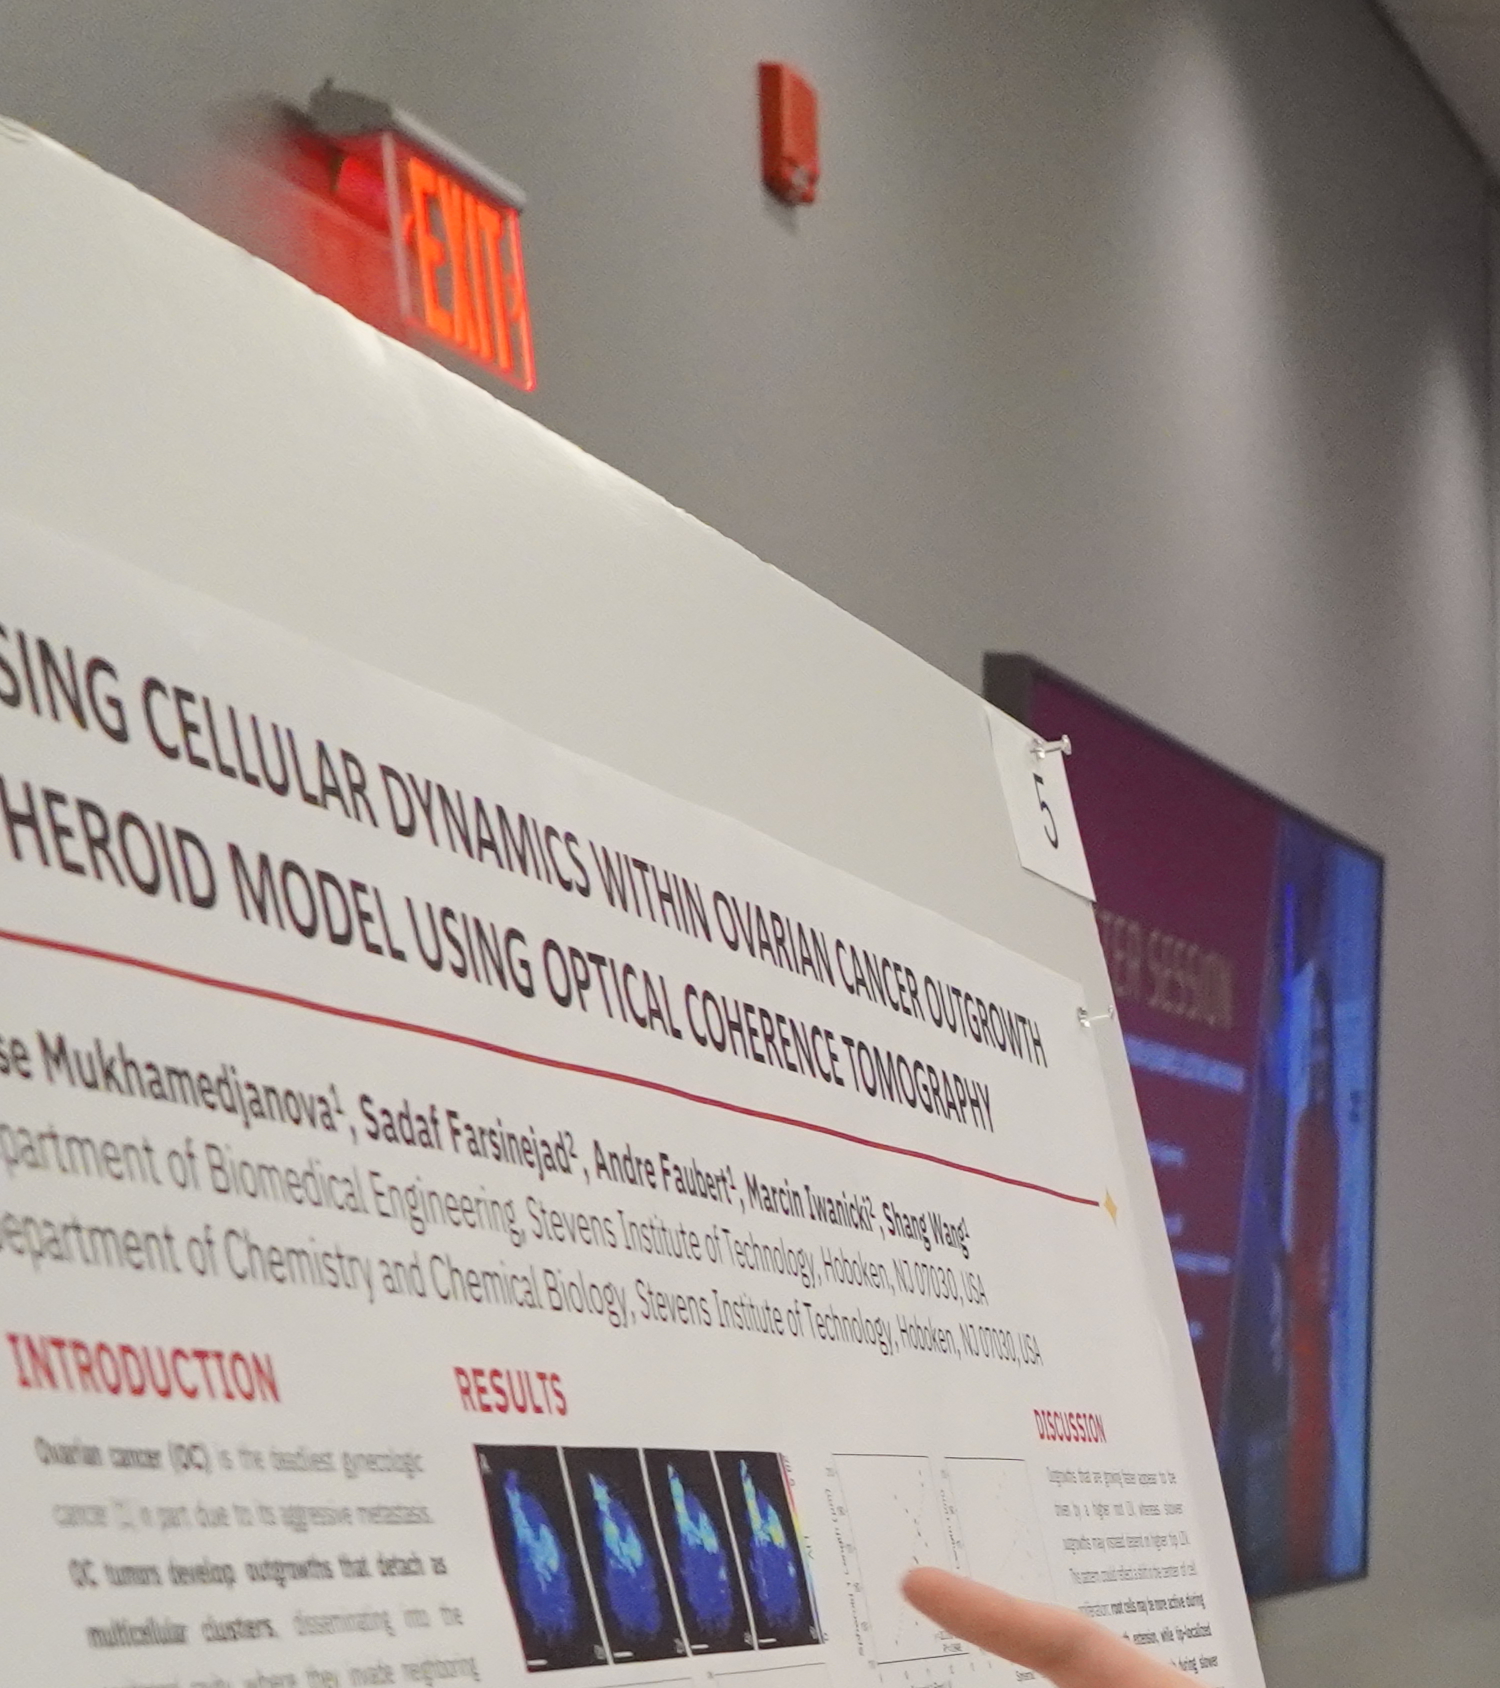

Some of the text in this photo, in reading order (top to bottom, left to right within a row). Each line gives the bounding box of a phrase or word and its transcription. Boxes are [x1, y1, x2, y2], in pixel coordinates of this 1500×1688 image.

[407, 156, 513, 374] EXIT
[142, 677, 379, 828] CELLULAR
[378, 763, 592, 898] DYNAMICS
[588, 839, 713, 943] WITHIN
[712, 890, 835, 987] OVARIAN
[836, 938, 926, 1022] CANCER
[924, 975, 1048, 1068] OUTGROWTH
[1033, 772, 1059, 849] 5
[228, 842, 406, 963] MODEL
[405, 896, 535, 999] USING
[542, 938, 683, 1040] OPTICAL
[685, 983, 845, 1087] COHERENCE
[840, 1034, 995, 1133] TOMOGRAPHY
[167, 1136, 201, 1190] of
[204, 1142, 369, 1214] Biomedical
[369, 1171, 526, 1248] Engineering,
[526, 1196, 617, 1249] Stevens
[617, 1209, 702, 1261] Institute
[705, 1224, 725, 1265] of
[722, 1228, 822, 1289] Technology,
[820, 1246, 895, 1296] Hoboken,
[893, 1258, 914, 1294] NJ
[961, 1272, 989, 1306] USA
[359, 1093, 444, 1151] Sadaf
[593, 1139, 657, 1189] Andre
[744, 1171, 805, 1219] Marcin
[882, 1201, 932, 1252] Shang
[6, 1332, 281, 1403] INTRODUCTION
[187, 1224, 218, 1276] of
[224, 1228, 374, 1303] Chemistry
[379, 1252, 427, 1298] and
[430, 1253, 543, 1310] Chemical
[635, 1278, 712, 1326] Stevens
[712, 1289, 785, 1335] Institute
[787, 1299, 805, 1337] of
[803, 1302, 900, 1356] Technology,
[1018, 1333, 1044, 1367] USA
[454, 1366, 567, 1416] RESULTS
[1033, 1409, 1107, 1443] DISCUSSION
